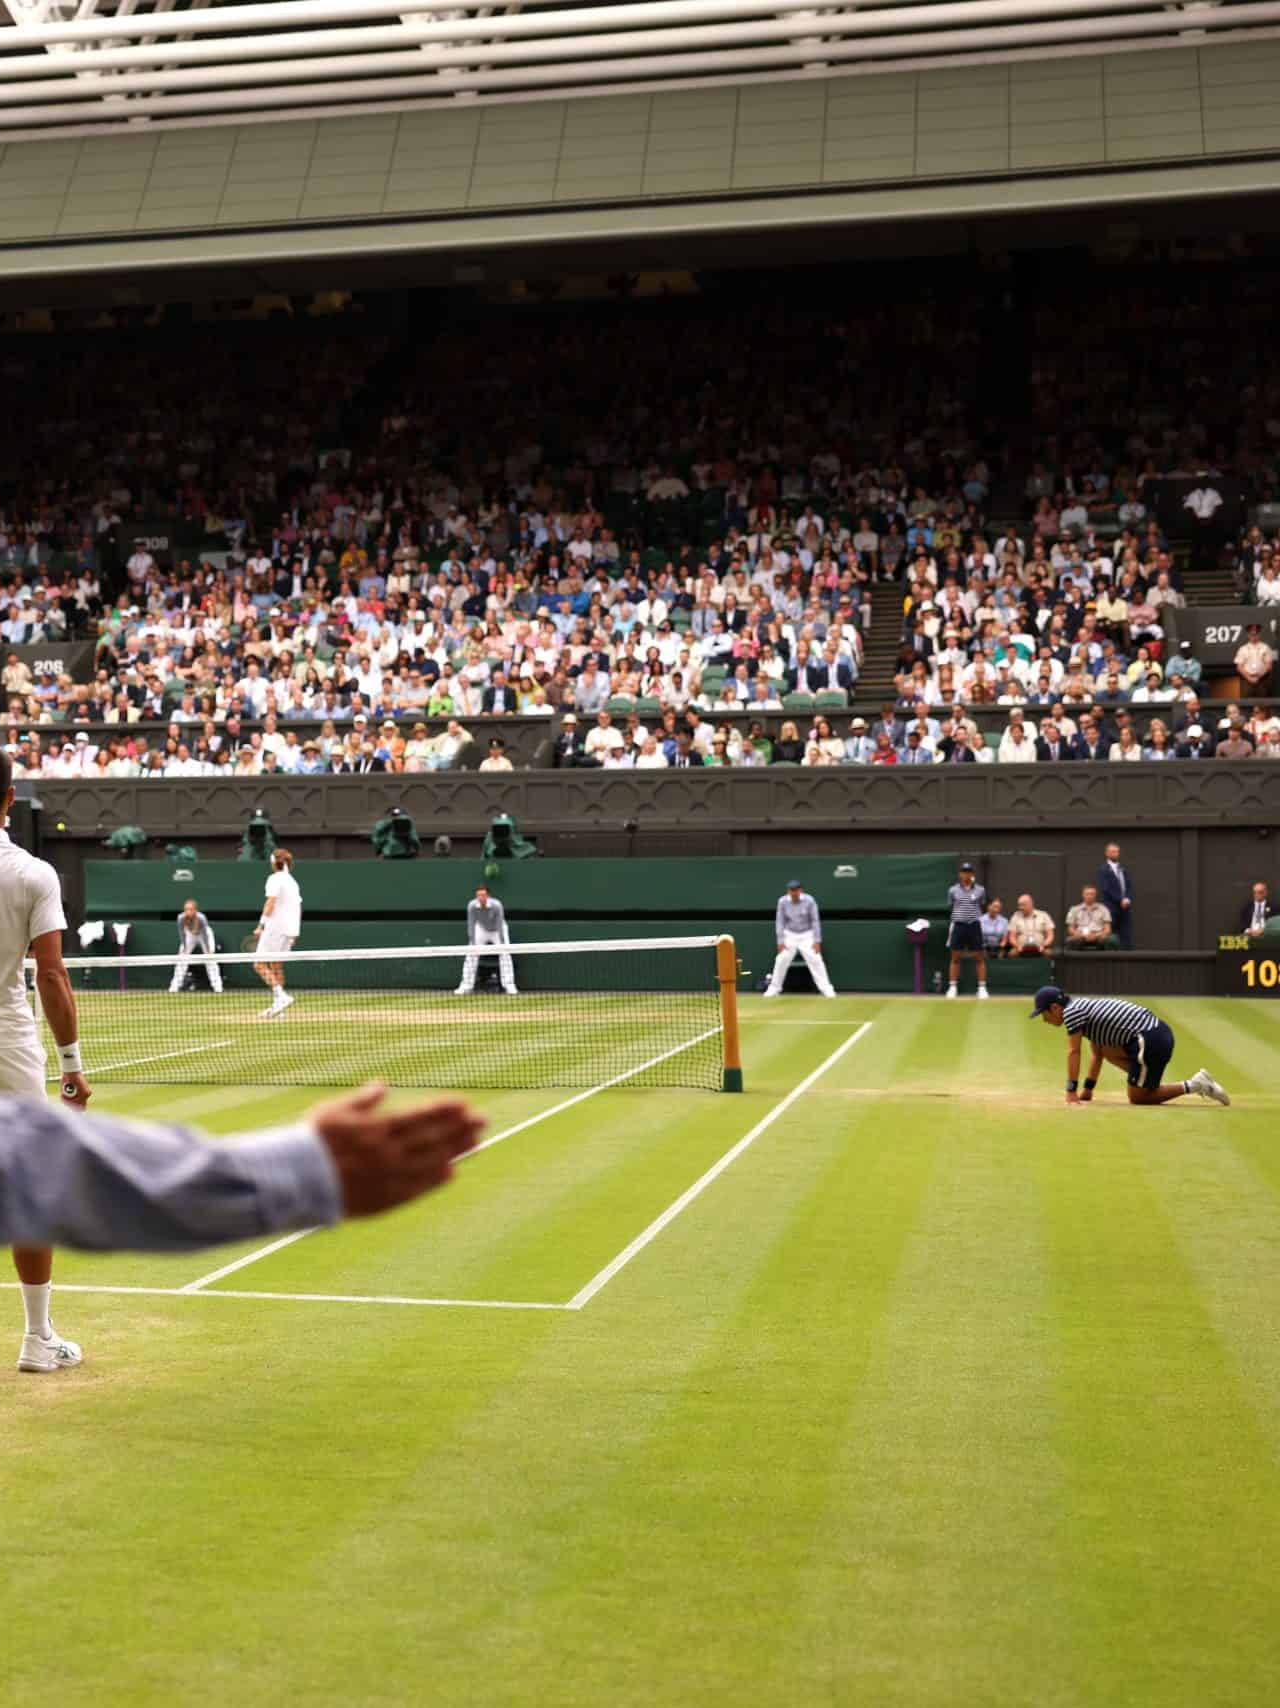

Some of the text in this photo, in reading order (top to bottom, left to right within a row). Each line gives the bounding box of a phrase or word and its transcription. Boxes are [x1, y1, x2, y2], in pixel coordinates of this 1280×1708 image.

[1205, 625, 1242, 643] 207
[1219, 935, 1249, 950] IBM
[1241, 959, 1280, 988] 10
